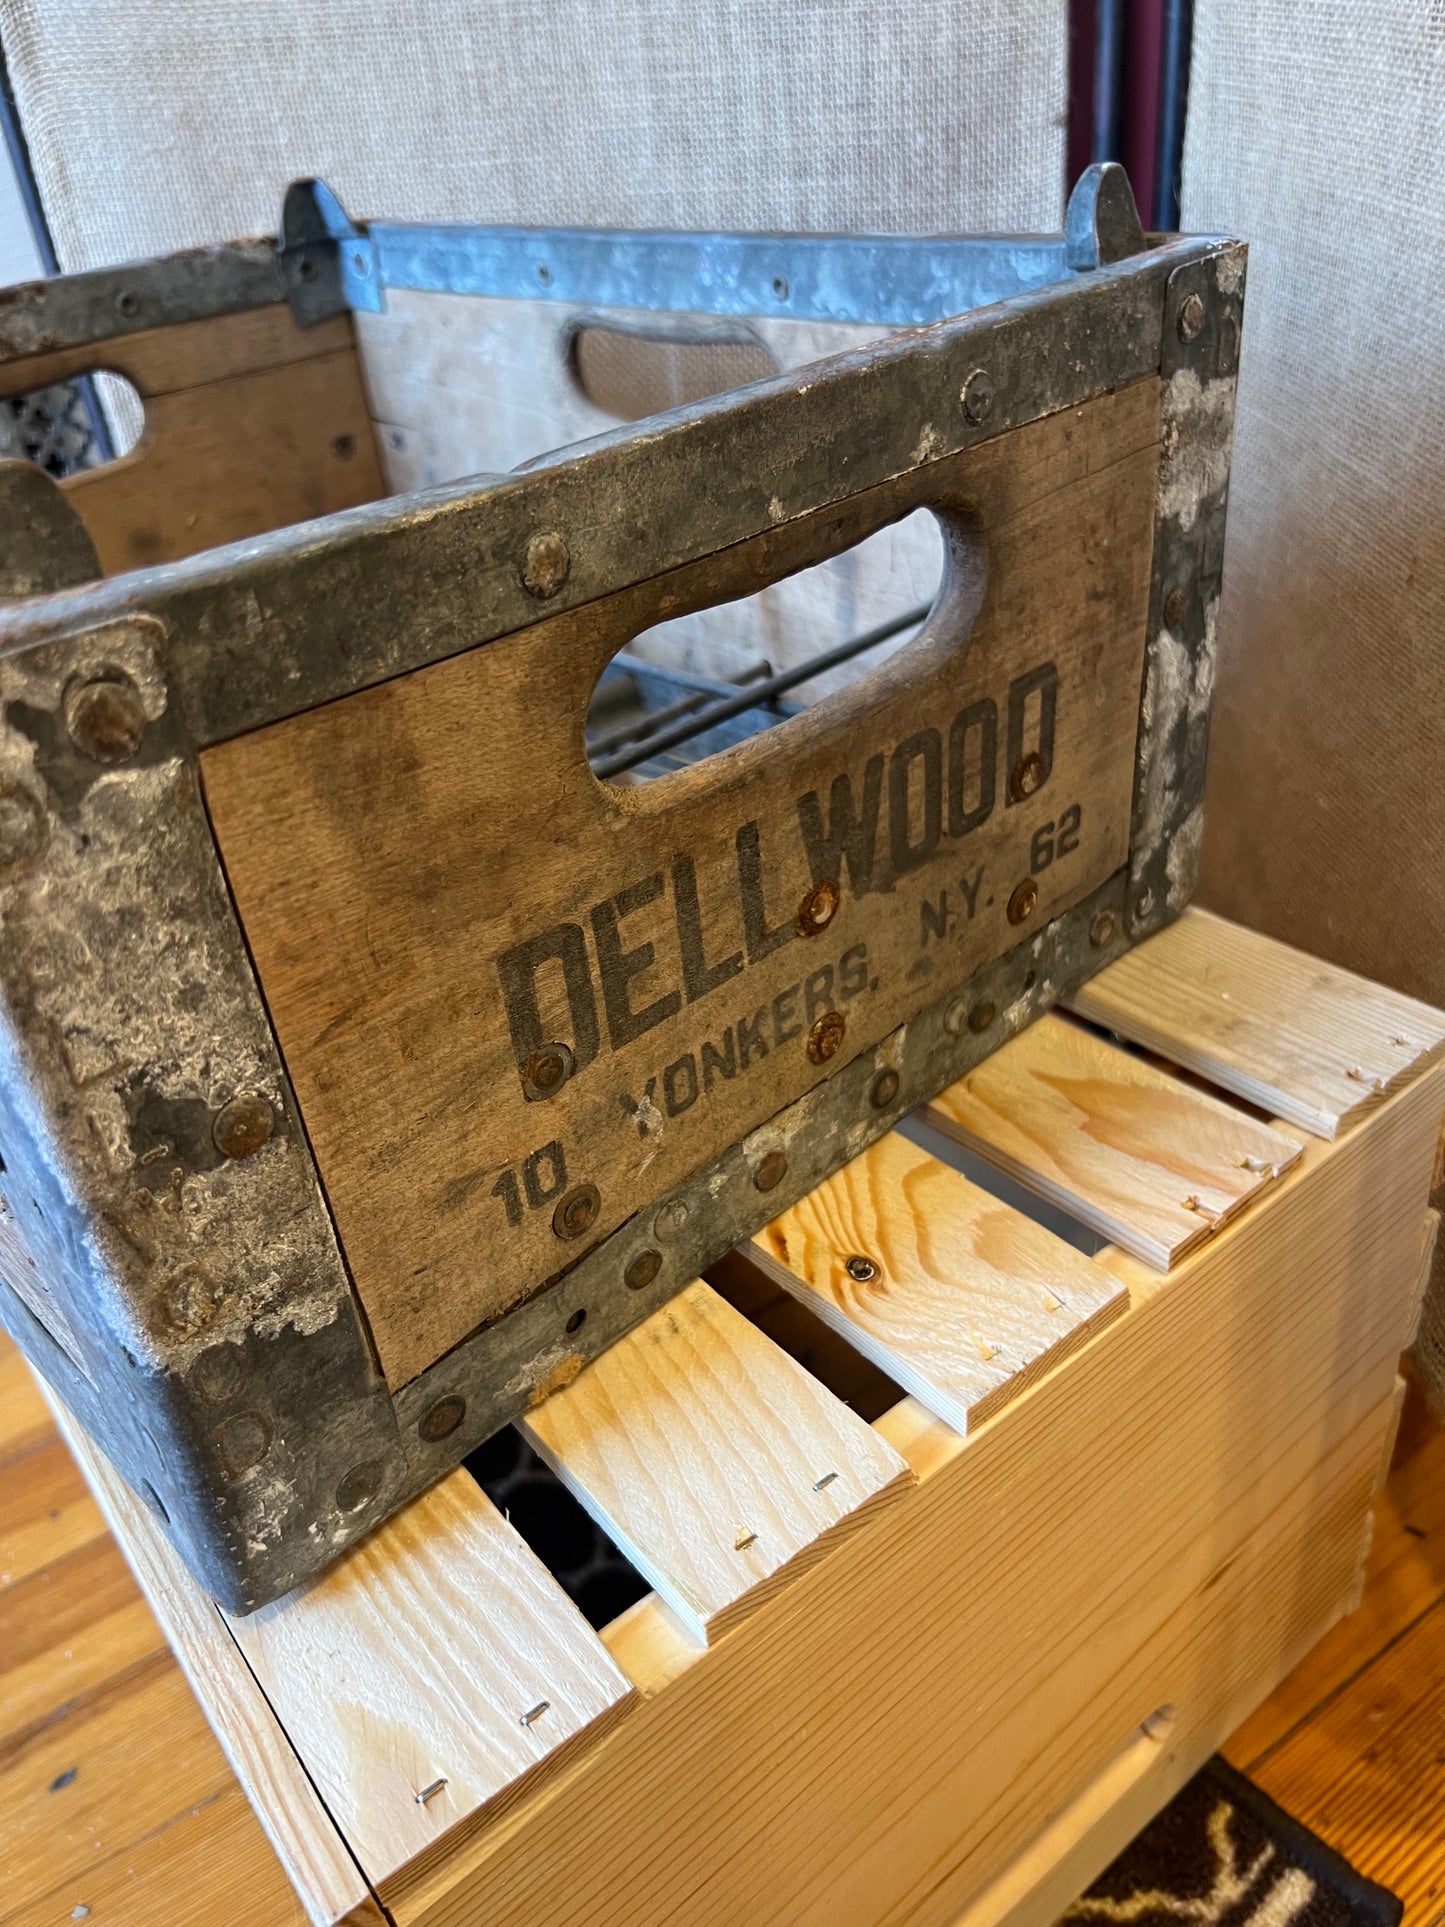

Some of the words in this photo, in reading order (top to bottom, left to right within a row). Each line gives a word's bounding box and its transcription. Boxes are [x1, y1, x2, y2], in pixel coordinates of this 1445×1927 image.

[490, 1139, 568, 1228] 10
[1030, 804, 1081, 875] 62
[495, 661, 1058, 1101] DELLWOOD
